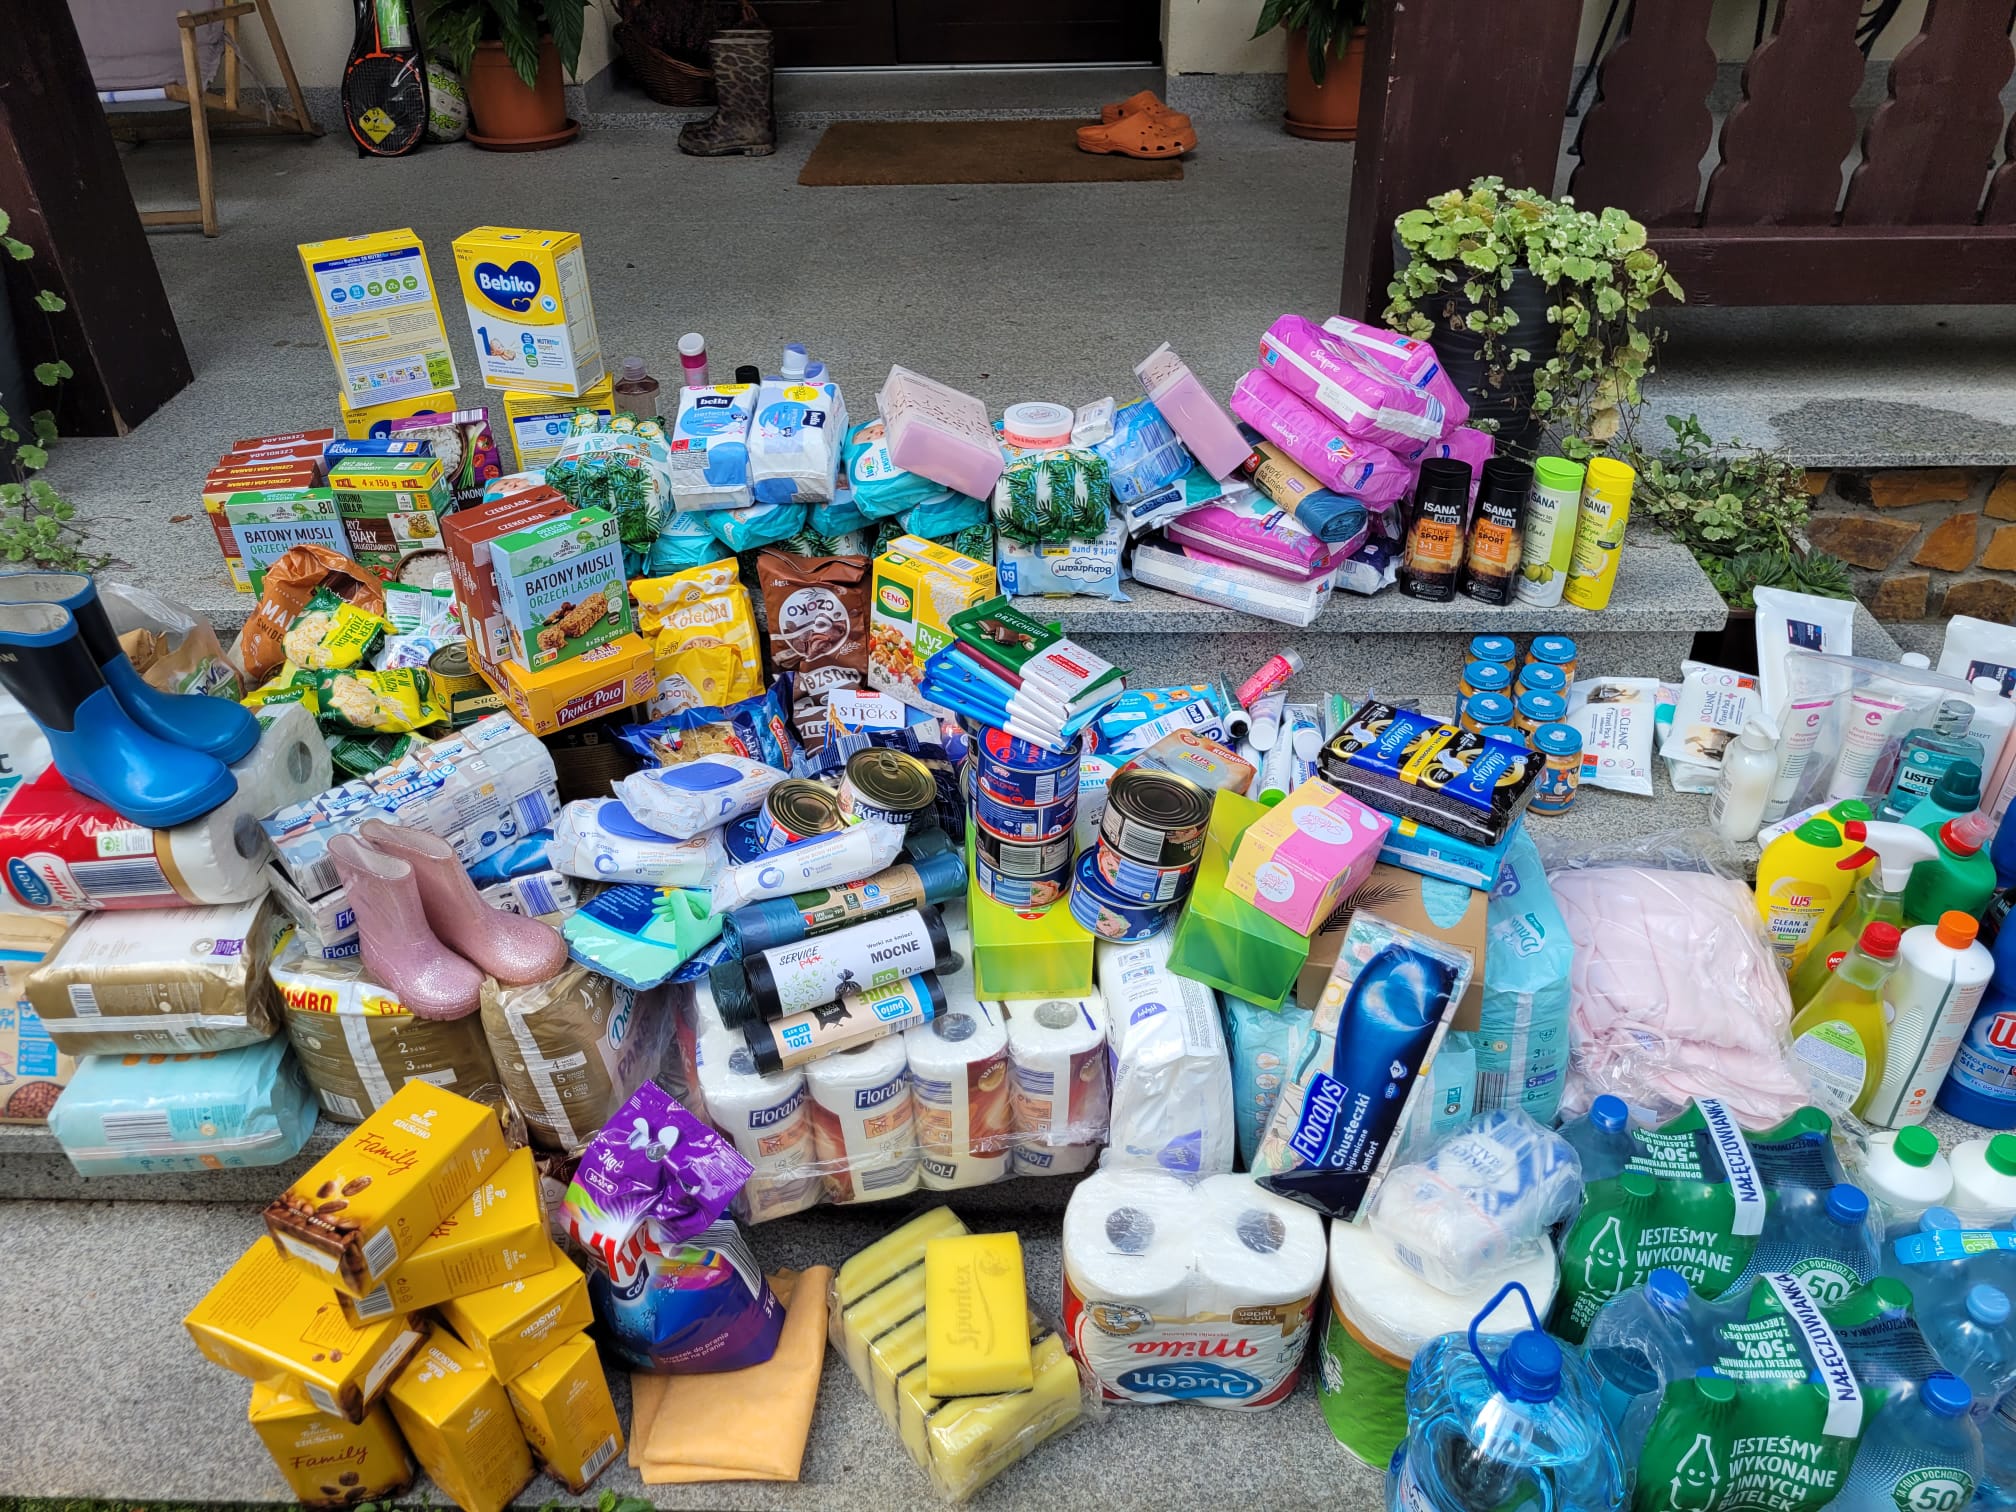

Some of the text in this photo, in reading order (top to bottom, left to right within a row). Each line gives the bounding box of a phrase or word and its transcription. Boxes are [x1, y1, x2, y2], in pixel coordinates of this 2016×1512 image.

[479, 273, 536, 293] Bebiko
[477, 326, 492, 356] 1
[700, 398, 728, 406] bella
[262, 434, 304, 443] CZEKOLADA
[250, 449, 293, 458] CZEKOLADA
[1259, 470, 1268, 479] na
[336, 478, 356, 488] XXL
[362, 479, 367, 488] 4
[375, 479, 391, 488] 150
[392, 481, 397, 489] g
[401, 479, 423, 489] XXL
[484, 498, 532, 516] CZEKOLADA
[1423, 502, 1458, 514] ISANA
[1482, 502, 1514, 517] ISANA
[1531, 493, 1556, 510] ISANA
[1583, 497, 1606, 515] ISANA
[346, 519, 360, 531] RYŻ
[498, 513, 545, 531] CZEKOLADA
[1434, 516, 1460, 525] MEN
[1492, 517, 1515, 527] MEN
[244, 527, 334, 543] BATONY MUSLI
[350, 531, 377, 543] BIAŁY
[1420, 533, 1449, 542] SPORT
[1421, 526, 1450, 536] ACTIVE
[1477, 533, 1505, 544] SPORT
[1478, 526, 1506, 537] ACTIVE
[250, 543, 288, 554] ORZECH
[1071, 546, 1091, 555] pure
[1101, 546, 1117, 556] soft
[525, 552, 614, 596] BATONY MUSLI
[1002, 570, 1016, 582] 60
[1058, 564, 1112, 575] Babydream
[529, 568, 617, 609] ORZECH LASKOWY
[880, 590, 909, 609] CENOS
[667, 602, 729, 628] Kółeczka
[787, 600, 834, 617] czoko
[361, 620, 374, 637] SER
[919, 628, 942, 650] Ryż
[560, 687, 621, 722] PRINCE POLO
[1701, 691, 1717, 715] CLEANIC
[839, 707, 898, 721] STICKS
[1380, 723, 1414, 753] always
[1618, 718, 1631, 751] CLEANIC
[1213, 748, 1250, 766] KUCHNIA
[1473, 752, 1507, 784] always
[369, 763, 457, 808] Samelle
[1904, 782, 1929, 792] COOL
[15, 865, 49, 905] Queen
[1790, 896, 1813, 907] W5
[1771, 926, 1807, 934] SHINING
[1773, 919, 1800, 927] CLEAN
[779, 947, 820, 966] SERVICE
[870, 940, 921, 964] MOCNE
[901, 967, 912, 976] 10
[859, 982, 905, 1005] PURE
[880, 1003, 907, 1018] purio
[398, 1043, 408, 1054] 2
[787, 1035, 813, 1048] 120L
[405, 1060, 415, 1070] 3
[1960, 1057, 1985, 1076] SIŁA
[556, 1074, 566, 1083] 5
[1528, 1077, 1536, 1087] 5
[563, 1088, 573, 1098] 6
[752, 1094, 806, 1127] Floralys
[1291, 1074, 1347, 1160] Floralys
[1331, 1094, 1371, 1168] Chusteczki
[355, 1132, 421, 1176] Family
[1345, 1129, 1369, 1172] higieniczne
[1647, 1145, 1688, 1162] 50%
[1701, 1098, 1759, 1203] NAŁĘCZOWIANKA
[1652, 1168, 1702, 1179] OPAKOWANIE
[1668, 1160, 1701, 1170] BUTELKI
[1637, 1226, 1719, 1248] JESTEŚMY
[1636, 1247, 1734, 1273] WYKONANE
[1809, 1259, 1849, 1276] POCHODZI
[1632, 1271, 1643, 1286] Z
[1806, 1275, 1844, 1301] 50
[945, 1263, 979, 1350] Spontex
[520, 1305, 562, 1339] EDUSCHO
[702, 1341, 726, 1357] pranie
[705, 1332, 729, 1349] prania
[1737, 1340, 1787, 1359] 50%
[1766, 1358, 1803, 1369] BUTELKI
[1745, 1368, 1807, 1380] OPAKOWANIE
[1133, 1372, 1255, 1396] Queen
[289, 1446, 369, 1470] Family
[1730, 1435, 1824, 1464] JESTEŚMY
[1729, 1456, 1838, 1488] WYKONANE
[1900, 1468, 1964, 1491] FOLIA POCHODZI
[1723, 1474, 1807, 1501] Z INNYCH
[1915, 1486, 1957, 1512] 50
